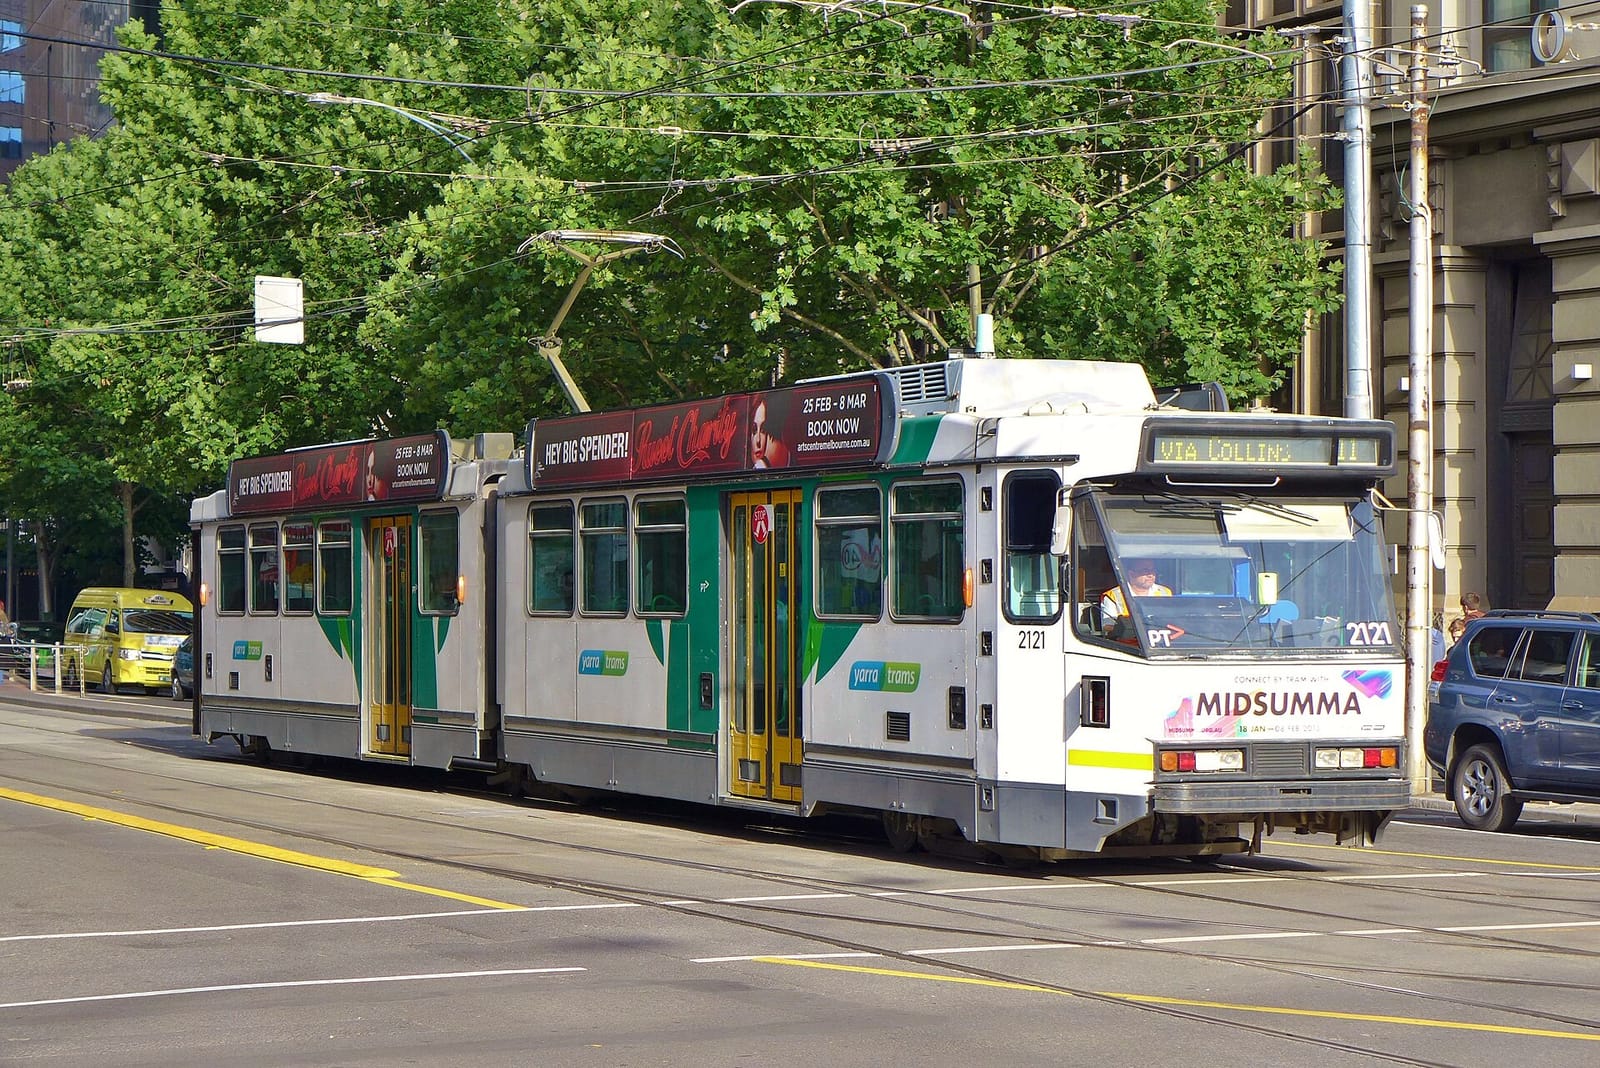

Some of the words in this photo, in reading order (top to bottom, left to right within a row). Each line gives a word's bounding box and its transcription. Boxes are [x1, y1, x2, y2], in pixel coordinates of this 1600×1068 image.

[803, 399, 813, 414] 25
[815, 397, 831, 413] FEB
[839, 396, 846, 410] 8
[847, 393, 866, 409] MAR
[807, 420, 834, 437] BOOK
[835, 417, 860, 435] NOW
[395, 447, 402, 459] 25
[402, 446, 413, 458] FEB
[421, 444, 434, 456] MAR
[545, 442, 562, 465] HEY
[563, 440, 578, 463] BIG
[580, 432, 629, 462] SPENDER!
[797, 439, 870, 452] artscentremelbourne.com.au
[1161, 441, 1197, 460] VIA
[397, 463, 413, 477] BOOK
[413, 462, 429, 475] NOW
[238, 478, 249, 496] HEY
[249, 476, 260, 495] BIG
[260, 470, 292, 493] SPENDER!
[754, 509, 766, 521] STOP
[1018, 630, 1045, 649] 2121
[1346, 622, 1393, 646] 2121
[582, 655, 599, 672] yarra
[605, 655, 625, 670] trams
[854, 667, 879, 686] yarra
[887, 668, 915, 685] trams
[1234, 675, 1271, 684] CONNECT
[1196, 691, 1362, 716] MIDSUMMA
[1239, 725, 1248, 733] 18
[1250, 725, 1266, 733] JAN
